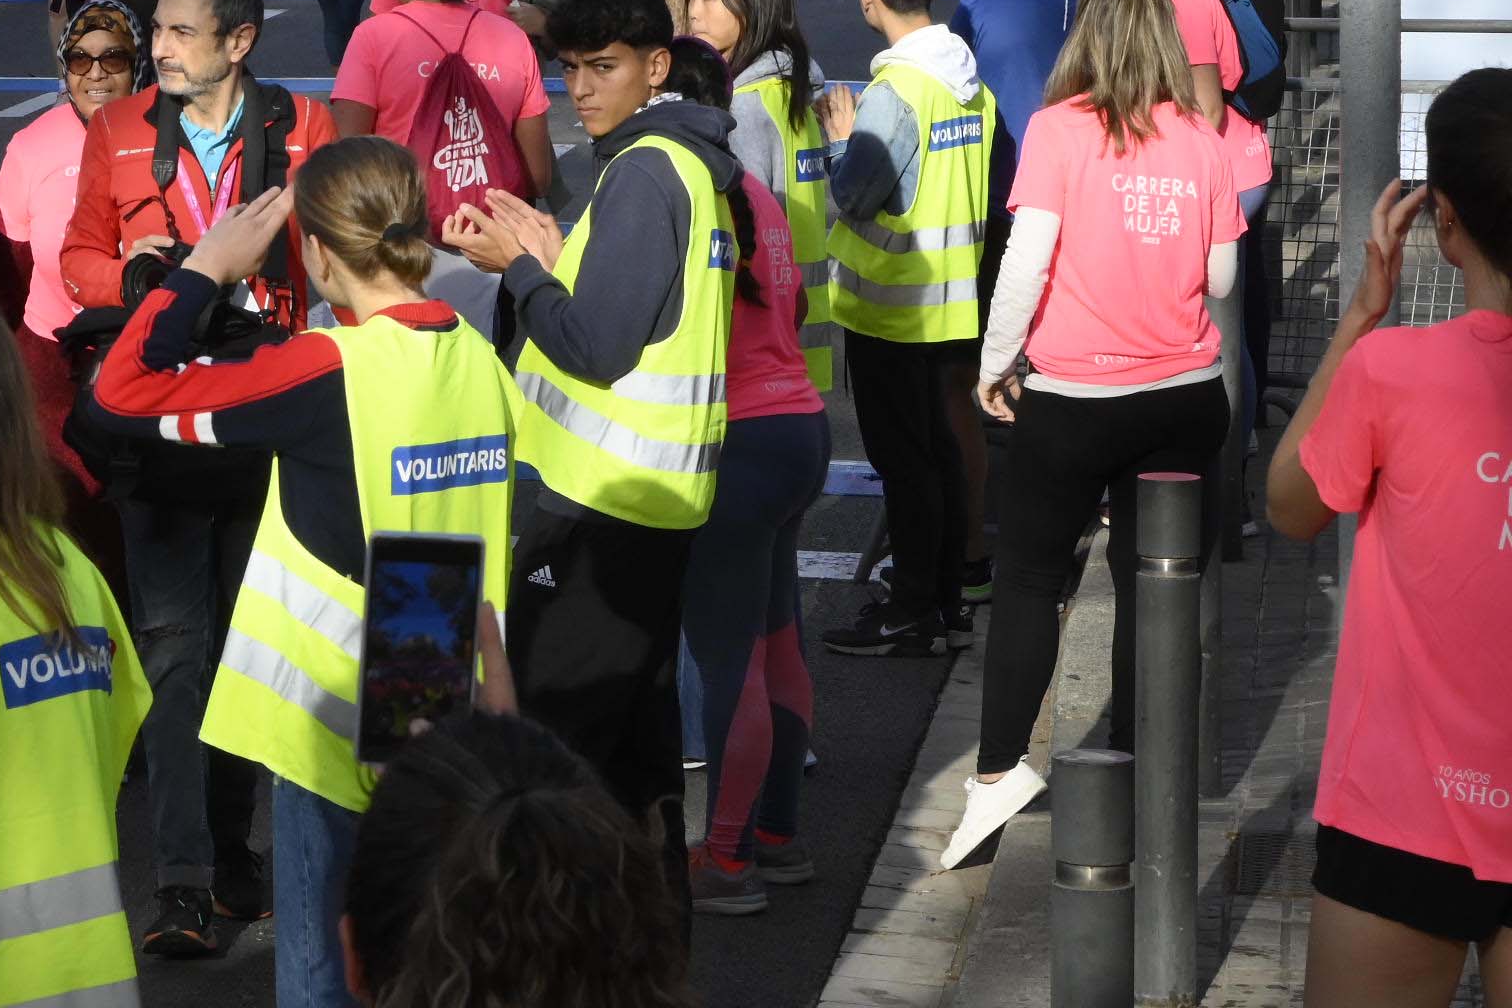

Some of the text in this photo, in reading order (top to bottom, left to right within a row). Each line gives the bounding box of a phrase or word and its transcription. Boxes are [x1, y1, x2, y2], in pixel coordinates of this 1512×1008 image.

[1111, 173, 1198, 199] CARRERA
[1124, 195, 1179, 217] DE LA
[1124, 215, 1181, 236] MUJER
[396, 447, 507, 484] VOLUNTARIS
[527, 573, 556, 588] adidas
[1453, 768, 1491, 785] AÑOS
[1434, 777, 1510, 808] YSHO
